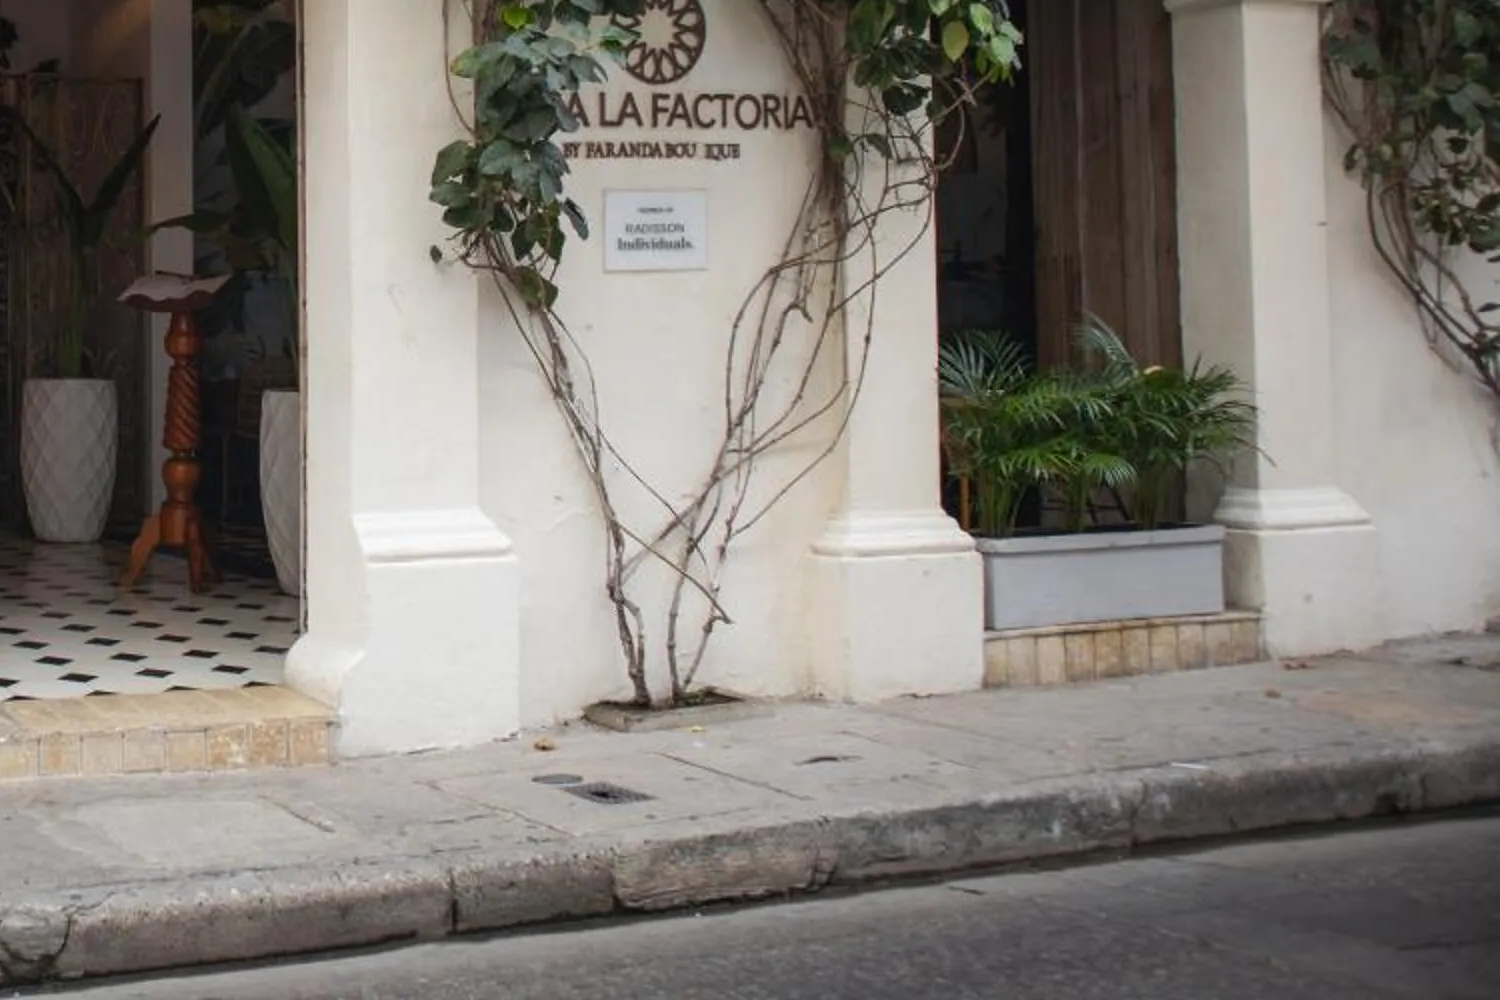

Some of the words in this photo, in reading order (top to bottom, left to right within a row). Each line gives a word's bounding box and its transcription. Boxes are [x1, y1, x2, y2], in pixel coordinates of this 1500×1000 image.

[599, 92, 644, 127] LA
[652, 93, 813, 130] FACTORIA
[563, 142, 581, 158] BY
